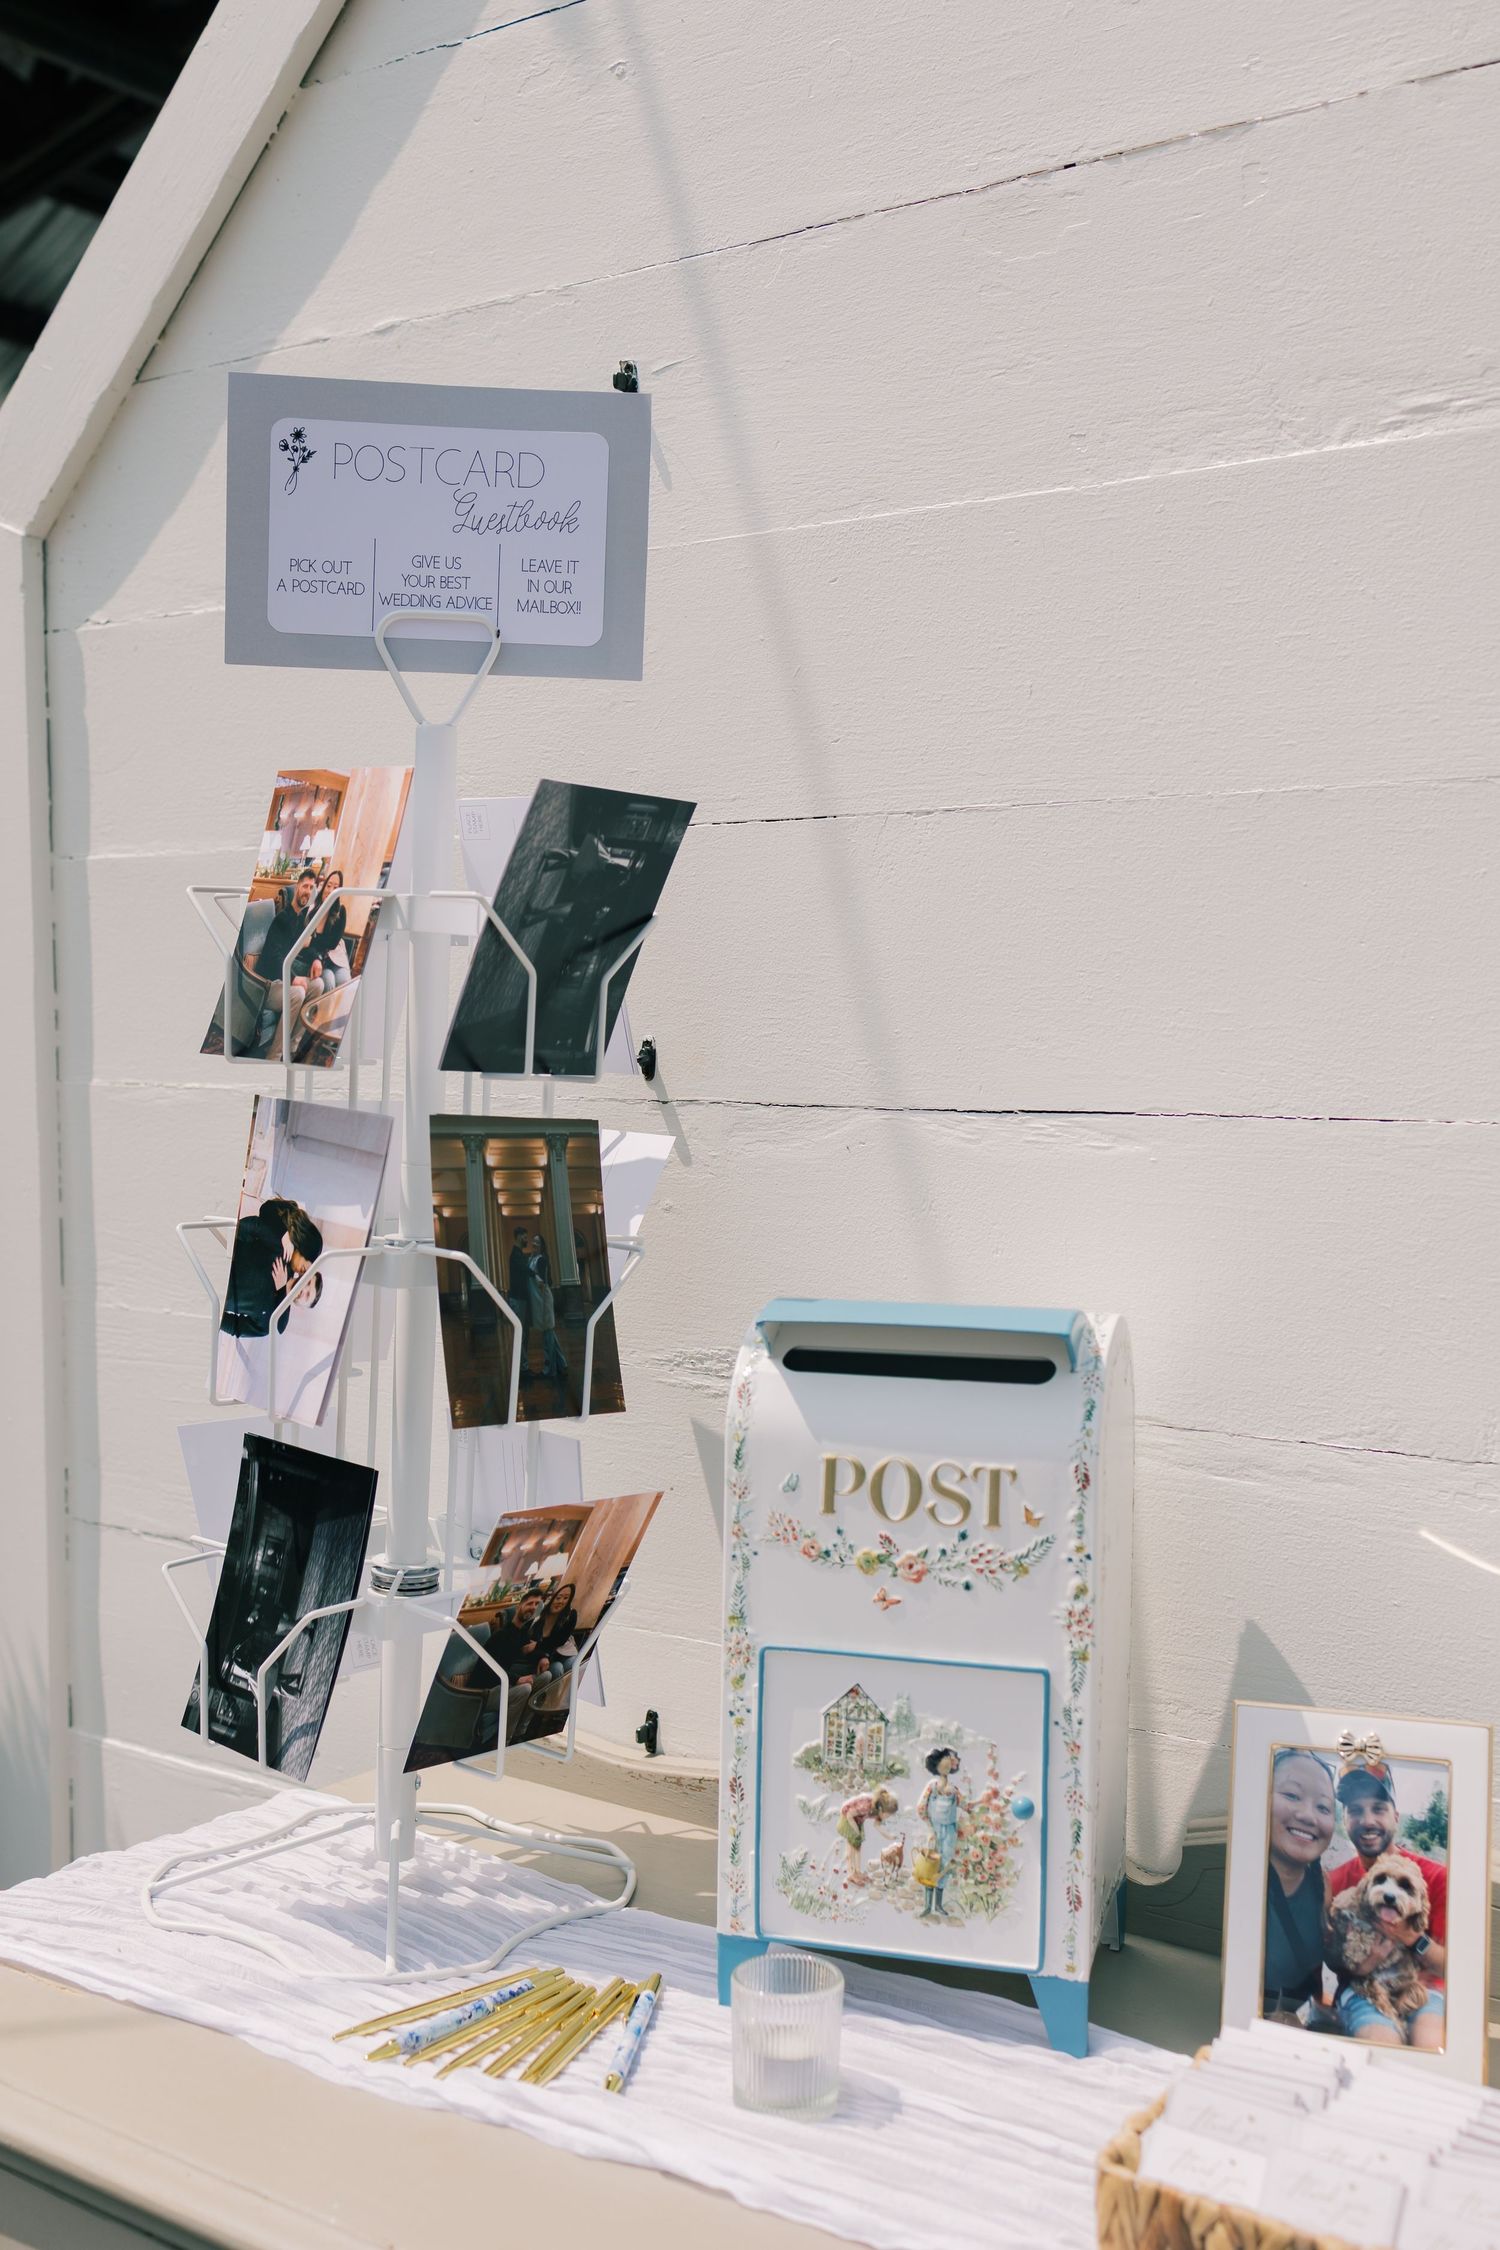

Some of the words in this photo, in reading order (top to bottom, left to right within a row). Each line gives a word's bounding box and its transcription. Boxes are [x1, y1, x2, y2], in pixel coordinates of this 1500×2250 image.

[333, 441, 546, 489] POSTCARD
[452, 488, 582, 536] Guestbook
[289, 557, 317, 574] PICK
[321, 559, 353, 575] OUT
[411, 554, 441, 569] GIVE
[444, 556, 462, 570] US
[520, 557, 562, 574] LEAVE
[566, 559, 580, 574] IT
[276, 577, 288, 593] A
[291, 578, 366, 596] POSTCARD
[401, 573, 436, 589] YOUR
[439, 575, 471, 590] BEST
[527, 578, 540, 593] IN
[543, 579, 573, 595] OUR
[378, 592, 442, 608] WEDDING
[445, 595, 494, 611] ADVICE
[516, 597, 582, 615] MAILBOX!!
[819, 1454, 1018, 1529] POST
